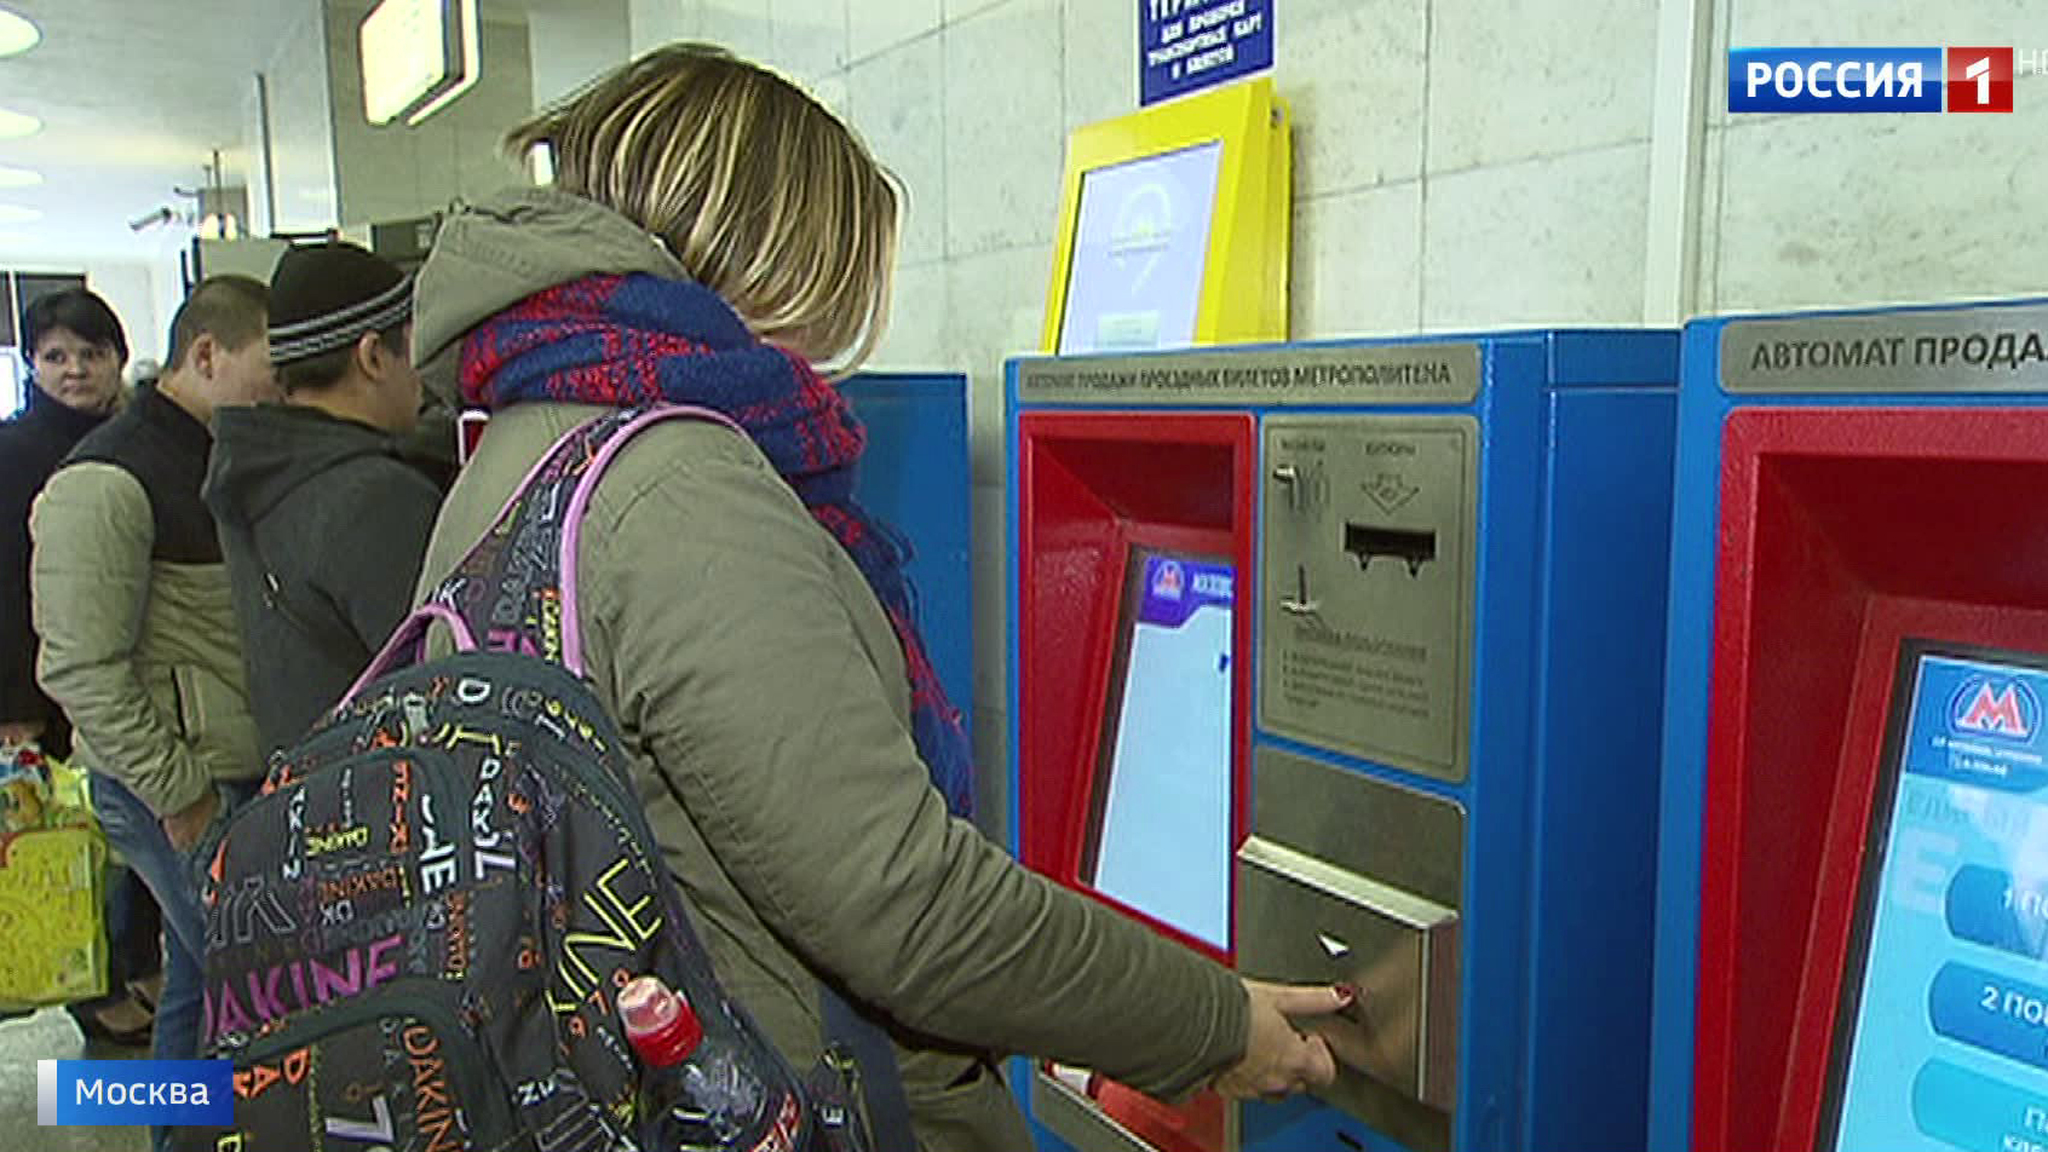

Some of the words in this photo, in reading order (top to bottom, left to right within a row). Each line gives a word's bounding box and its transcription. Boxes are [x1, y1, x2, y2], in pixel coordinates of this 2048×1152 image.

[1751, 337, 1905, 371] АВТОМАТ
[1914, 332, 2048, 371] ПРОДА
[1294, 361, 1452, 388] МЕТРОПОЛИТЕНА
[1980, 986, 1999, 1011] 2
[2003, 991, 2048, 1027] ПО
